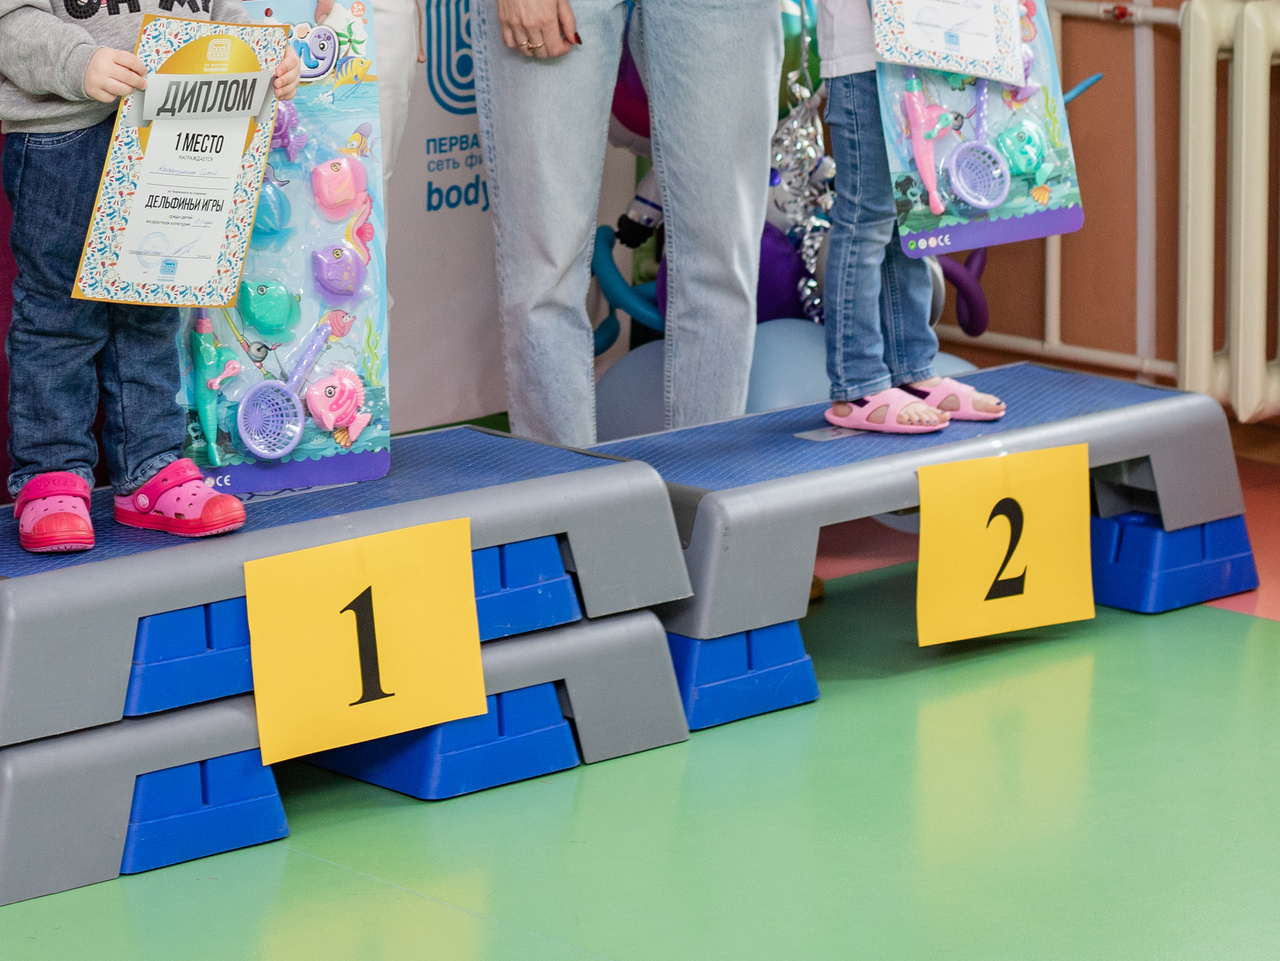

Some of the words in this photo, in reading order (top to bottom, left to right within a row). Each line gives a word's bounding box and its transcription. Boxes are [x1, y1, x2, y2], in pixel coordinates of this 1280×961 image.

[156, 78, 257, 117] ДИПЛОМ
[175, 133, 182, 151] 1
[183, 133, 224, 153] МЕСТО
[426, 133, 481, 155] ПЕРВА
[427, 158, 460, 173] сеть
[145, 194, 201, 211] ДЕЛЬФИНЬИ
[201, 199, 224, 212] ИГРЫ
[983, 496, 1027, 602] 2
[339, 584, 396, 707] 1
